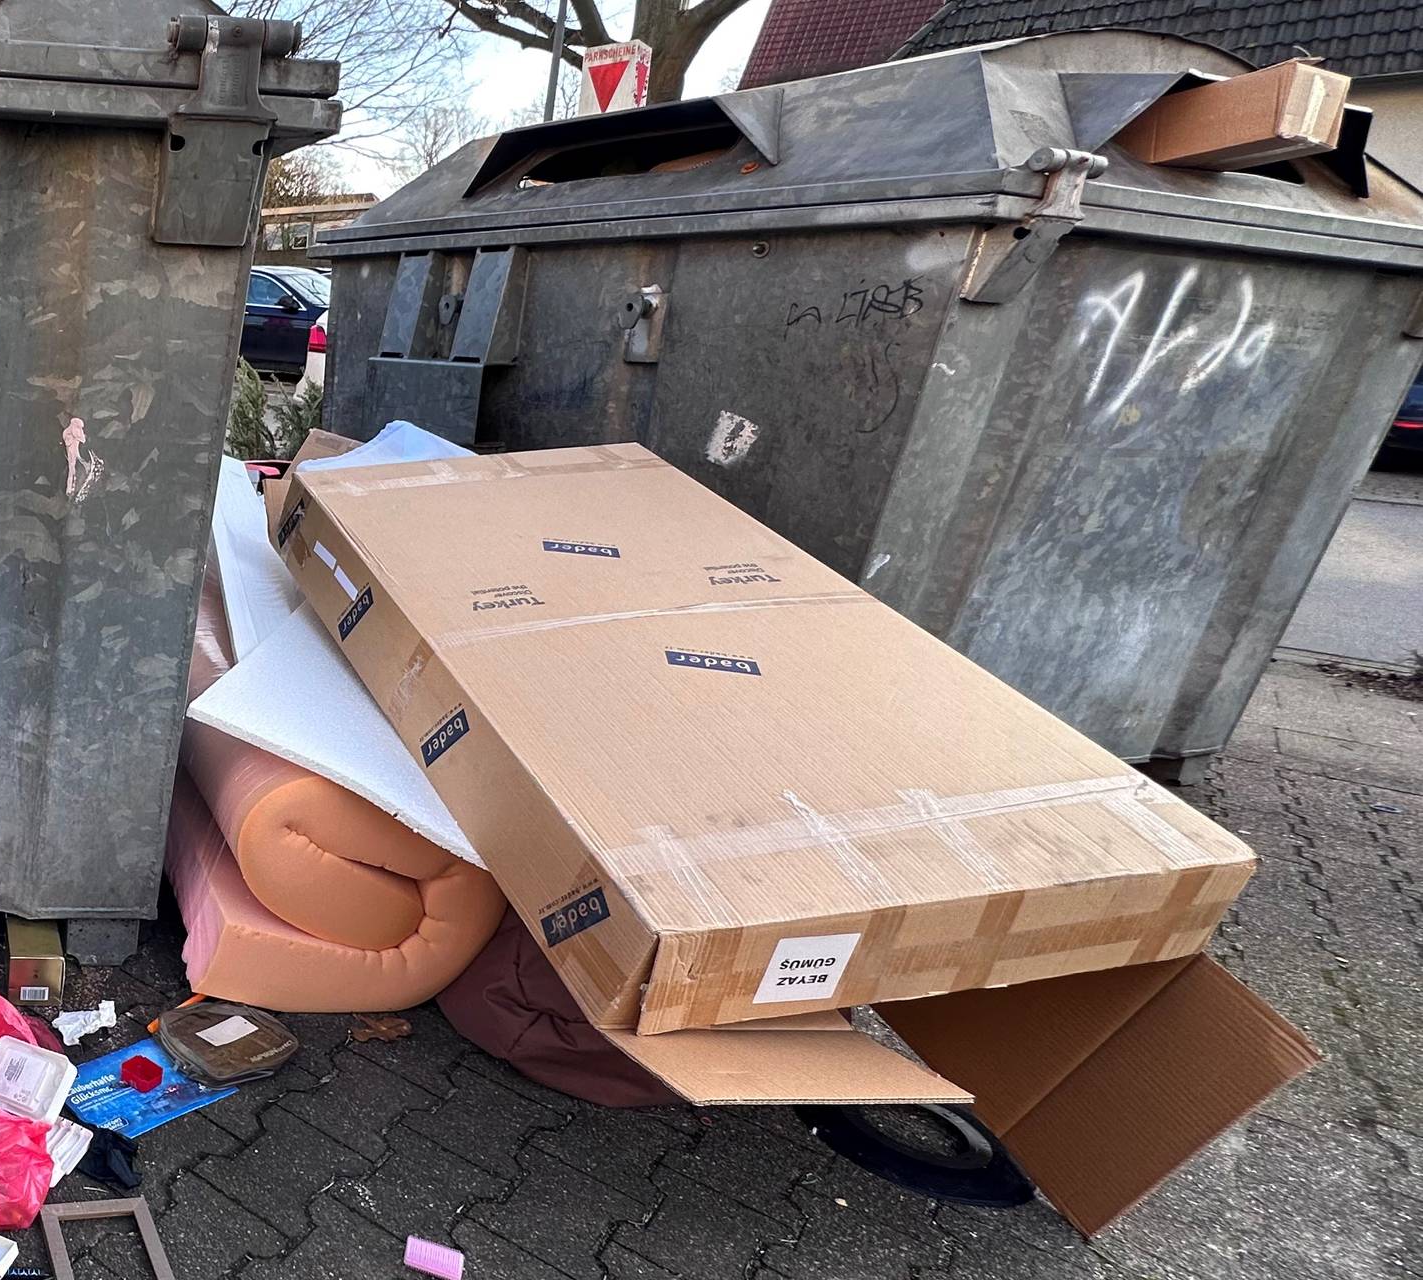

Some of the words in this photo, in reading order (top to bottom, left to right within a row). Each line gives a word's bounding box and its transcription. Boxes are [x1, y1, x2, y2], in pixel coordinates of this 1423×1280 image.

[550, 542, 613, 556] bader
[708, 574, 781, 586] Turkey
[473, 596, 545, 611] Turkey
[341, 592, 370, 632] bader
[675, 654, 752, 672] bader
[427, 717, 464, 757] bader
[550, 896, 602, 935] bader
[779, 957, 836, 971] GÜMÜŞ
[776, 974, 828, 986] BEYAZ
